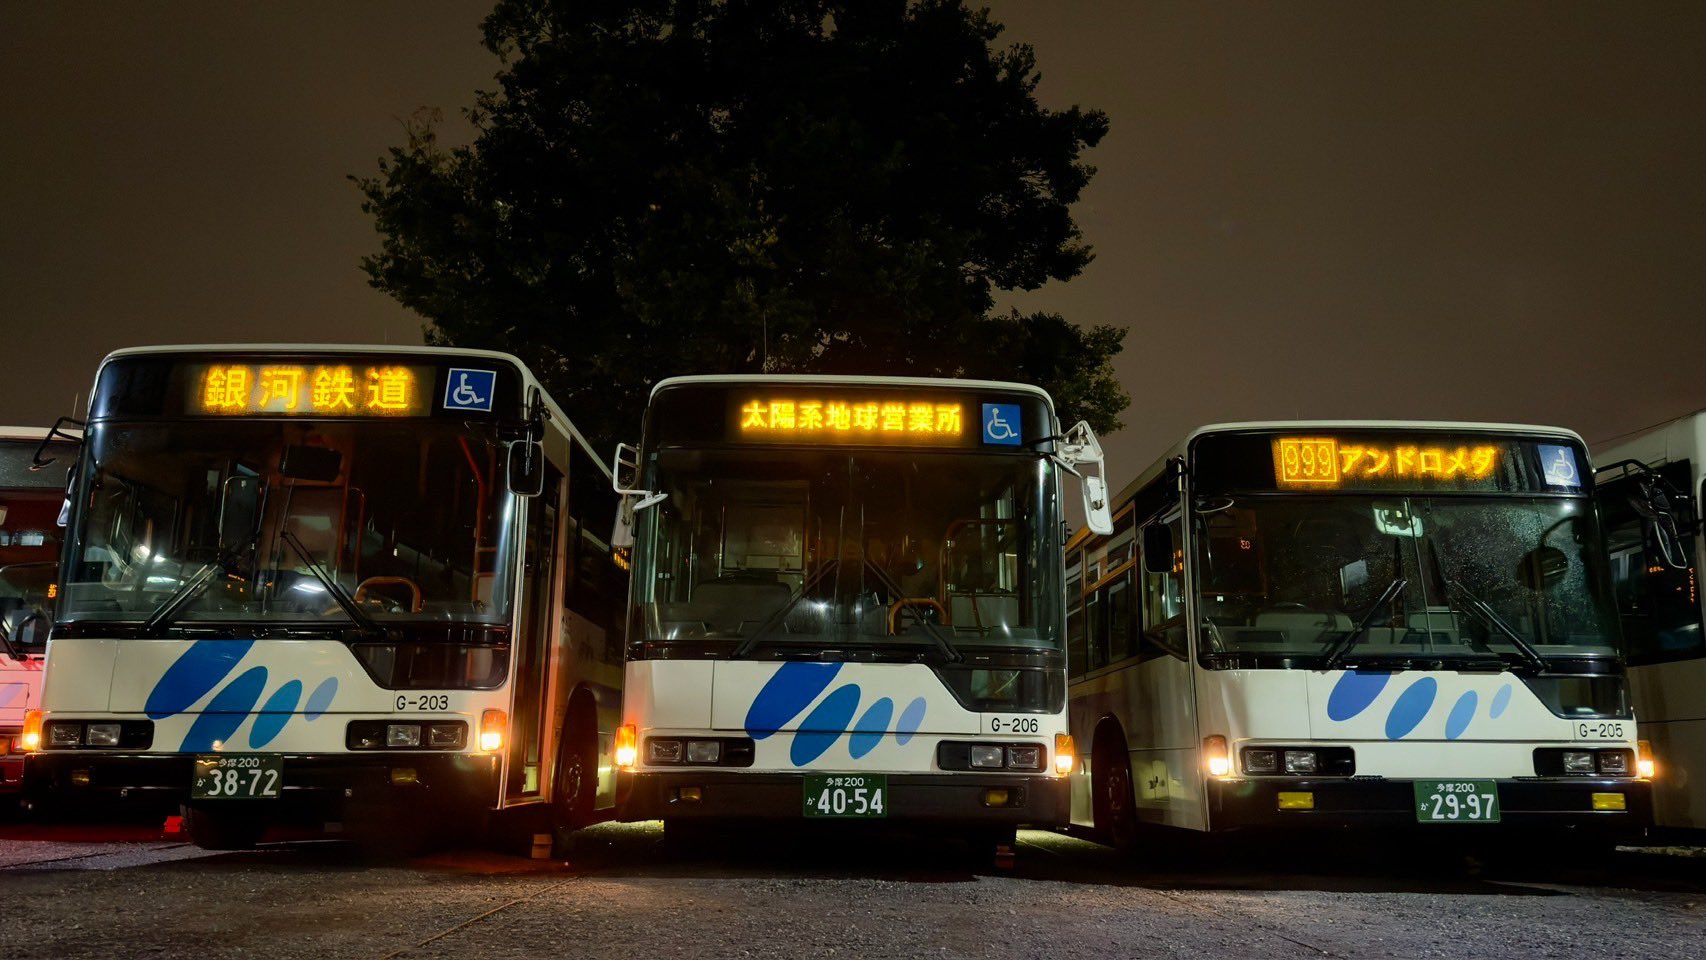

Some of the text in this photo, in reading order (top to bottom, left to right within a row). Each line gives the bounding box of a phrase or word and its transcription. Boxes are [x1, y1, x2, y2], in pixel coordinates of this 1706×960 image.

[205, 369, 409, 409] 銀河鉄道
[742, 402, 961, 432] 太陽系地球営業所
[1285, 445, 1496, 476] 999 アンドロメダ
[396, 695, 449, 710] G-203
[991, 717, 1038, 733] G-206
[1579, 723, 1623, 738] G-205
[207, 769, 278, 796] 38-72
[817, 788, 883, 814] 40-54
[1430, 794, 1495, 819] 29-97
